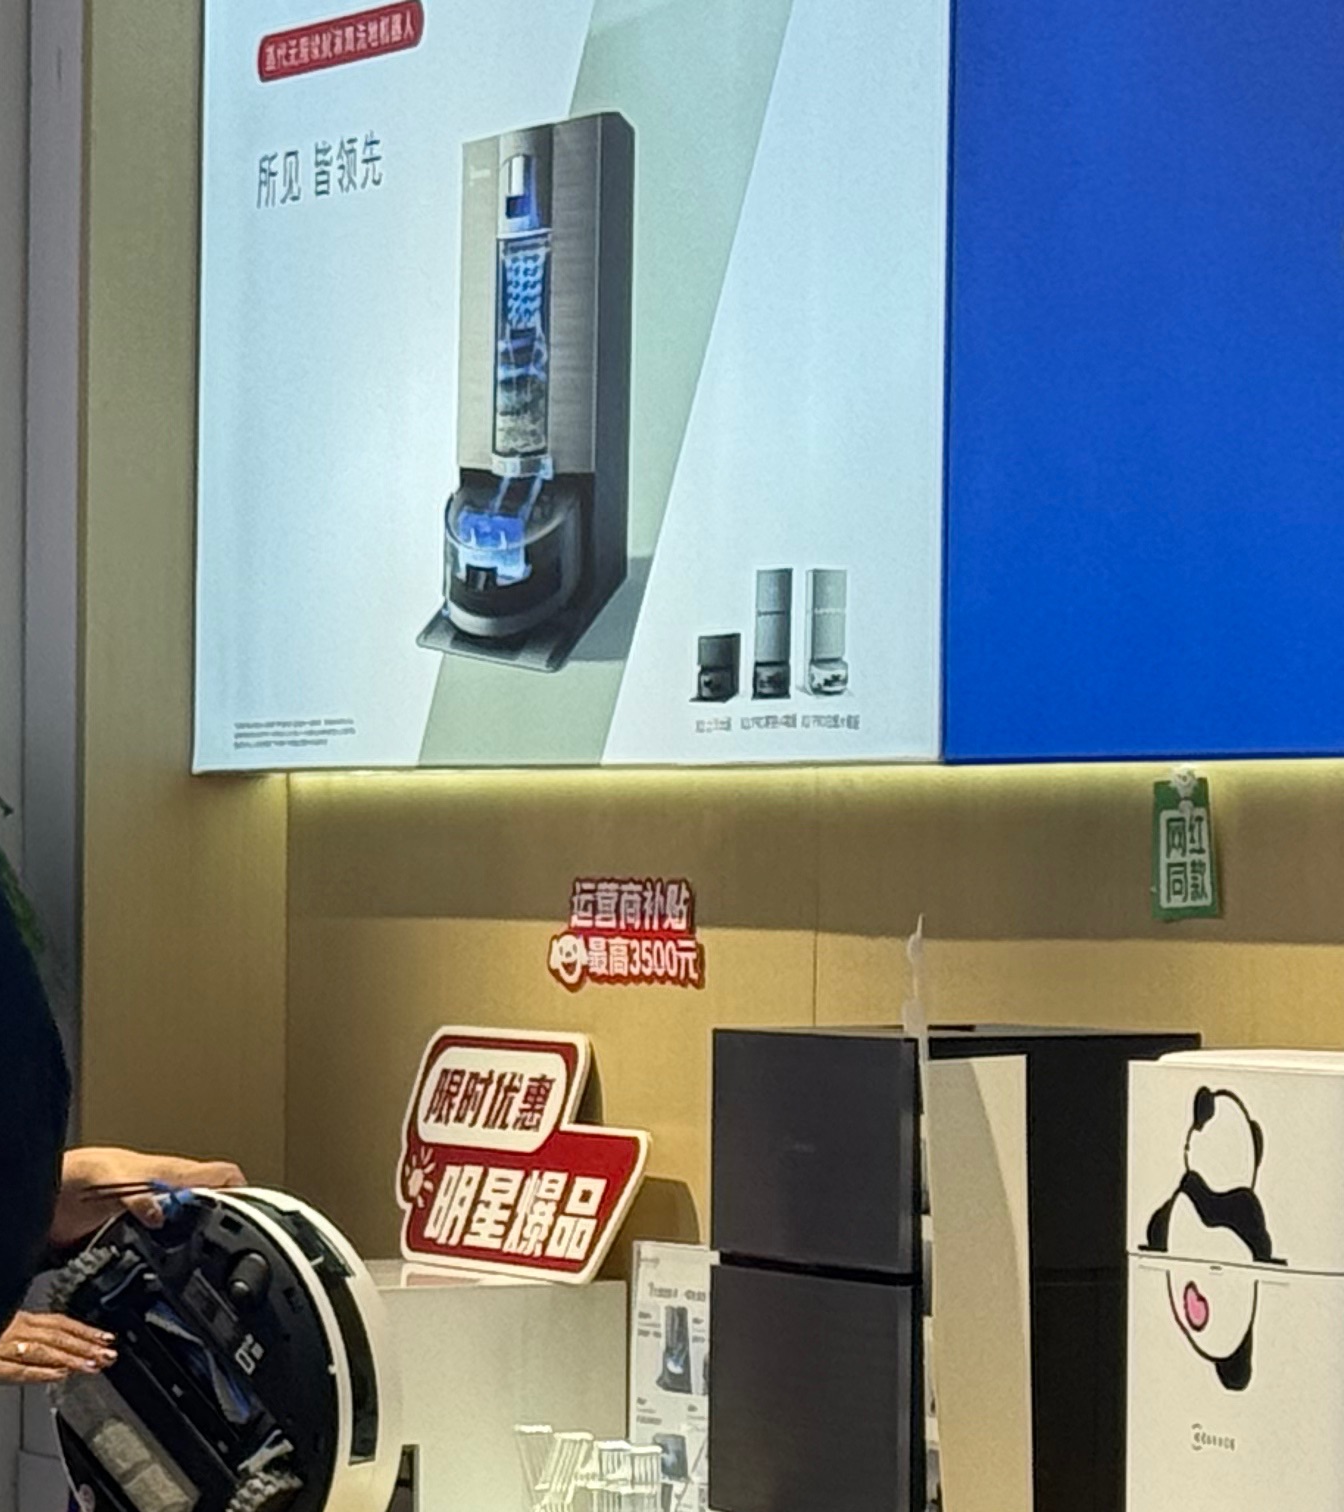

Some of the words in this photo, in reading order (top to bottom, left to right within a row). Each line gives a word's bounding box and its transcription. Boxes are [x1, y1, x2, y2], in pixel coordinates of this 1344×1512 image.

[256, 152, 302, 209] 所见
[314, 129, 383, 196] 皆领先
[1165, 814, 1206, 860] 网红
[571, 881, 691, 931] 运营商补贴
[1166, 858, 1209, 904] 同款
[587, 935, 699, 980] 最高3500元
[423, 1067, 557, 1133] 限时优惠
[423, 1164, 608, 1261] 明星爆品
